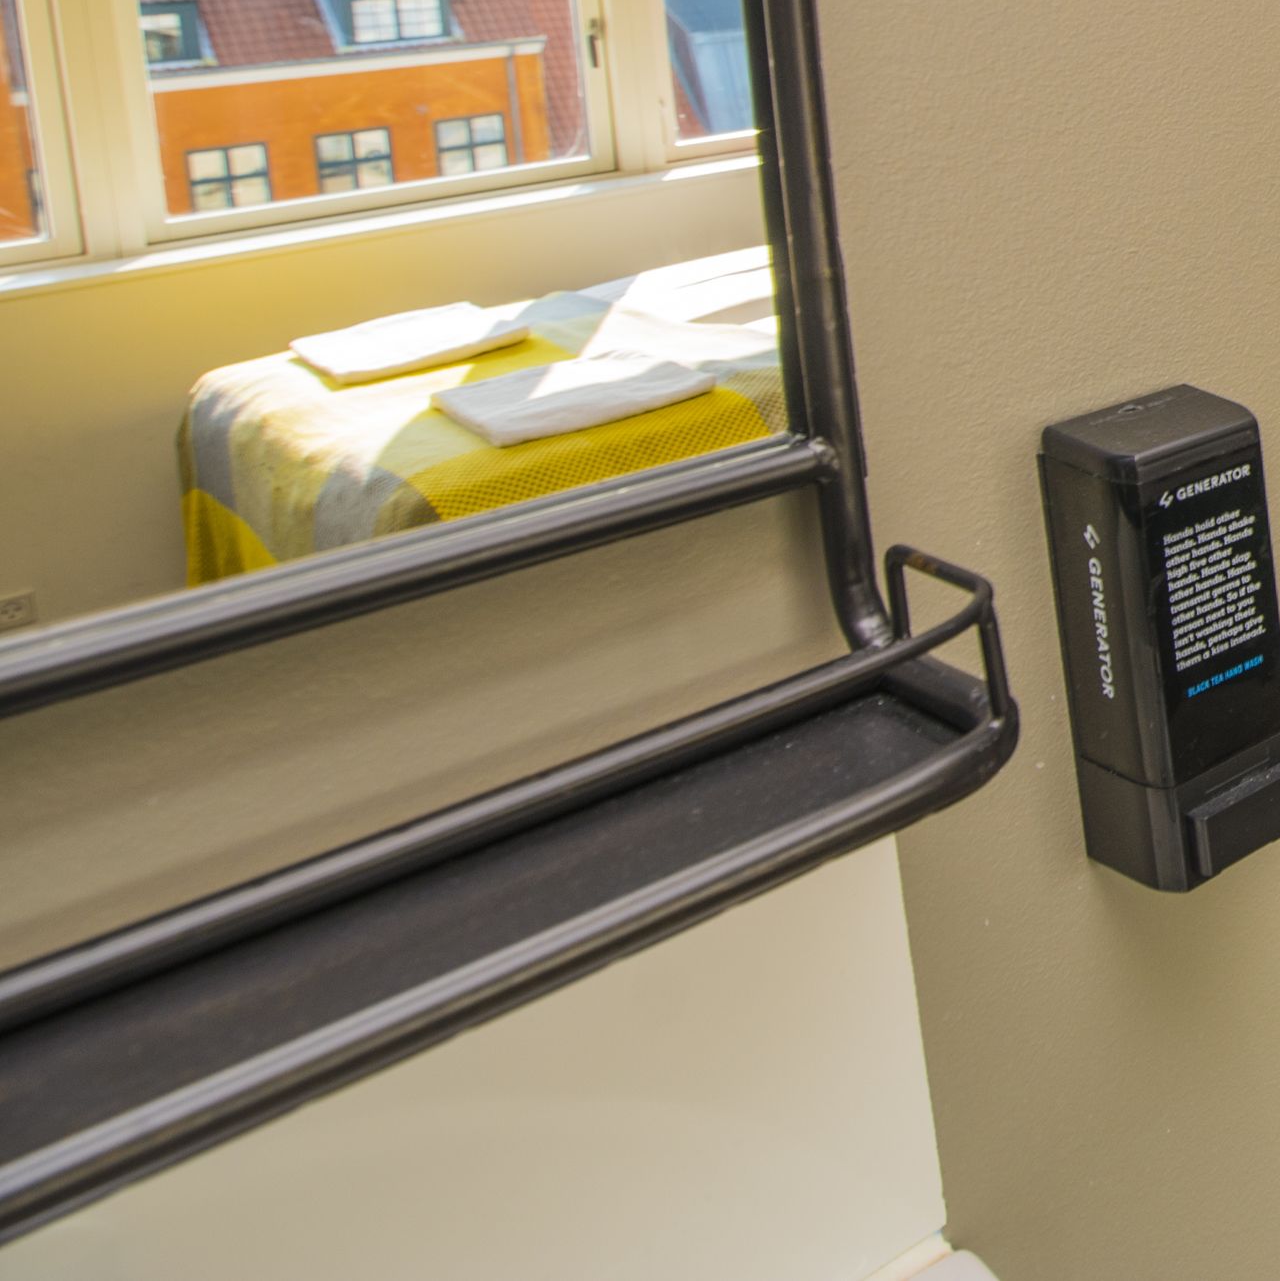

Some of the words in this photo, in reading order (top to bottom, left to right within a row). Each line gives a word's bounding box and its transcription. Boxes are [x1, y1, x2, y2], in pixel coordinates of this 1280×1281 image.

[1176, 464, 1251, 501] GENERATOR
[1163, 526, 1194, 545] Hands
[1195, 516, 1215, 533] hold
[1216, 509, 1240, 525] other
[1165, 539, 1196, 557] hands.
[1197, 526, 1227, 544] Hands
[1228, 515, 1255, 532] shake
[1166, 552, 1191, 568] other
[1191, 540, 1223, 558] hands.
[1224, 527, 1253, 545] Hands
[1167, 564, 1188, 581] high
[1190, 558, 1207, 571] five
[1208, 547, 1232, 563] other
[1168, 573, 1200, 592] hands.
[1201, 559, 1230, 578] Hands
[1231, 551, 1251, 565] slap
[1169, 586, 1194, 603] other
[1195, 574, 1226, 592] hands.
[1227, 560, 1256, 579] Hands
[1170, 591, 1211, 615] transmit
[1211, 579, 1240, 598] germs
[1241, 574, 1251, 584] to
[1171, 610, 1195, 626] other
[1196, 598, 1226, 615] hands.
[1226, 590, 1238, 602] So
[1239, 586, 1246, 597] if
[1247, 581, 1261, 593] the
[1088, 557, 1115, 699] GENERATOR
[1173, 618, 1204, 639] person
[1205, 608, 1225, 623] next
[1226, 604, 1236, 614] to
[1237, 596, 1254, 611] you
[1174, 632, 1194, 649] isn't
[1195, 616, 1234, 639] washing
[1234, 606, 1256, 622] their
[1208, 623, 1244, 648] perhaps
[1244, 614, 1264, 631] give
[1177, 654, 1202, 672] them
[1203, 650, 1210, 660] a
[1211, 641, 1229, 656] kiss
[1230, 624, 1267, 648] instead.
[1187, 679, 1210, 698] BLACK
[1210, 673, 1225, 686] TEA
[1225, 664, 1243, 680] HAND
[1243, 654, 1264, 670] WASH
